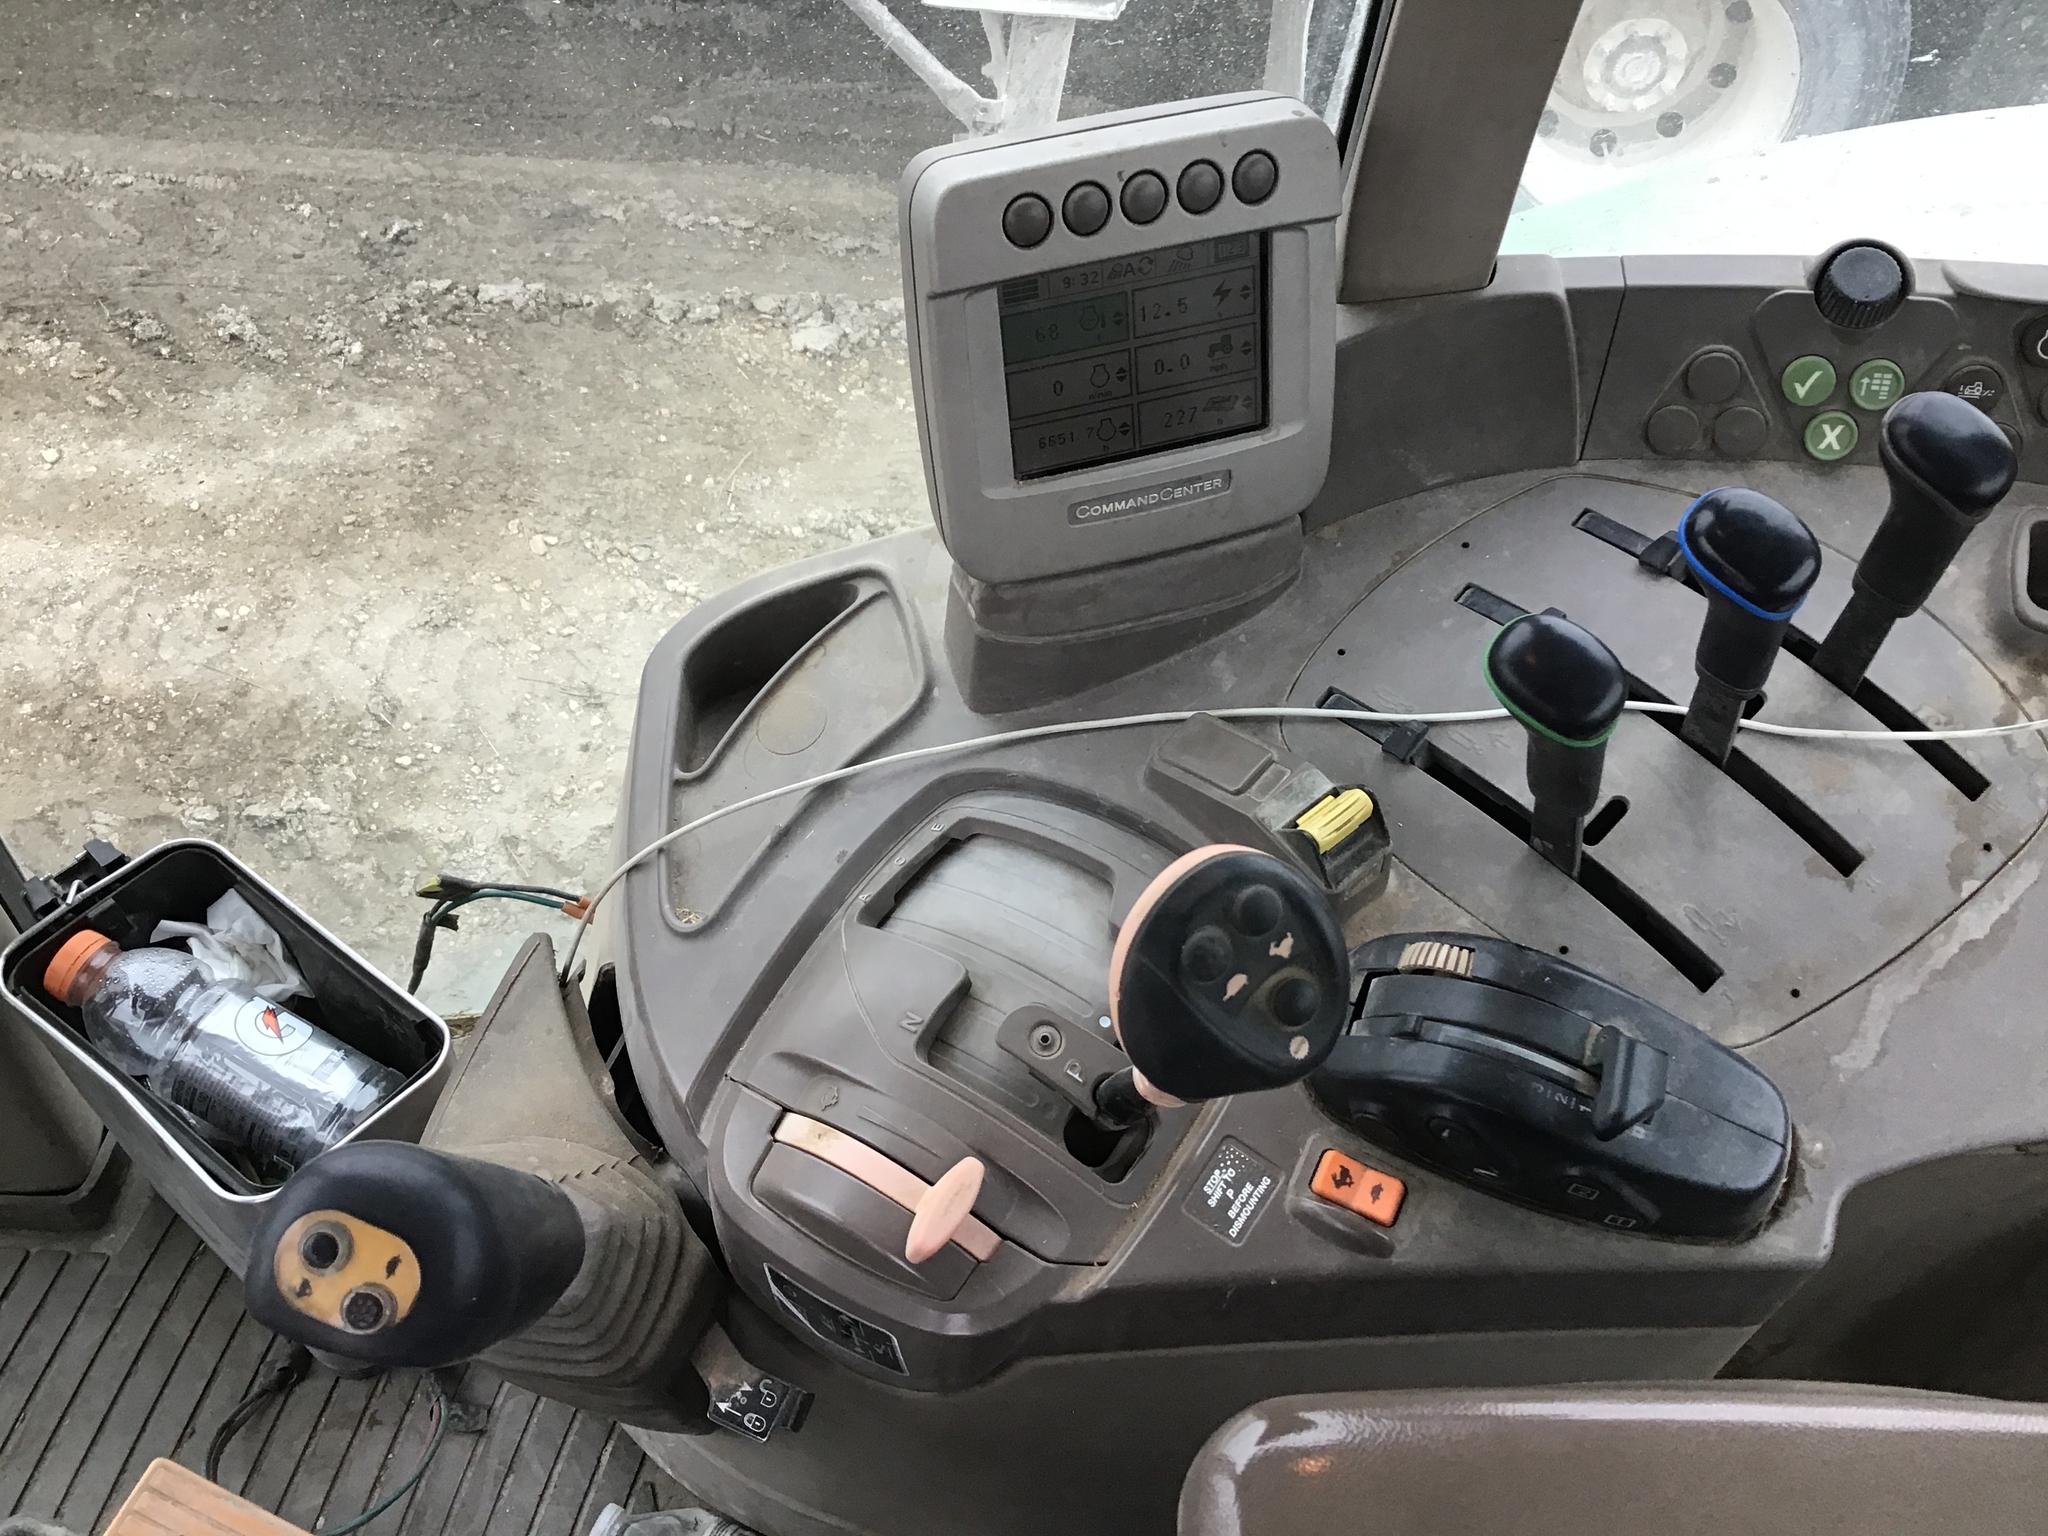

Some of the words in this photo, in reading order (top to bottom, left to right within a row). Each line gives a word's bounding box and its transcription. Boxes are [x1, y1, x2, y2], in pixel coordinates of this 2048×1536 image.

[1122, 259, 1137, 278] A
[1062, 270, 1099, 290] 9:32
[1139, 297, 1188, 322] 12.5
[1034, 323, 1060, 343] 68
[1153, 353, 1190, 375] 0.0
[1053, 380, 1063, 396] 0
[1163, 406, 1198, 428] 227
[899, 1011, 924, 1034] N
[1063, 1058, 1084, 1083] P
[1203, 1169, 1221, 1195] STOP
[1207, 1180, 1227, 1208] SHIFT
[1222, 1167, 1236, 1182] TO
[1226, 1188, 1234, 1200] P
[1227, 1181, 1255, 1219] BEFORE
[1228, 1176, 1271, 1238] DISMOUNTING
